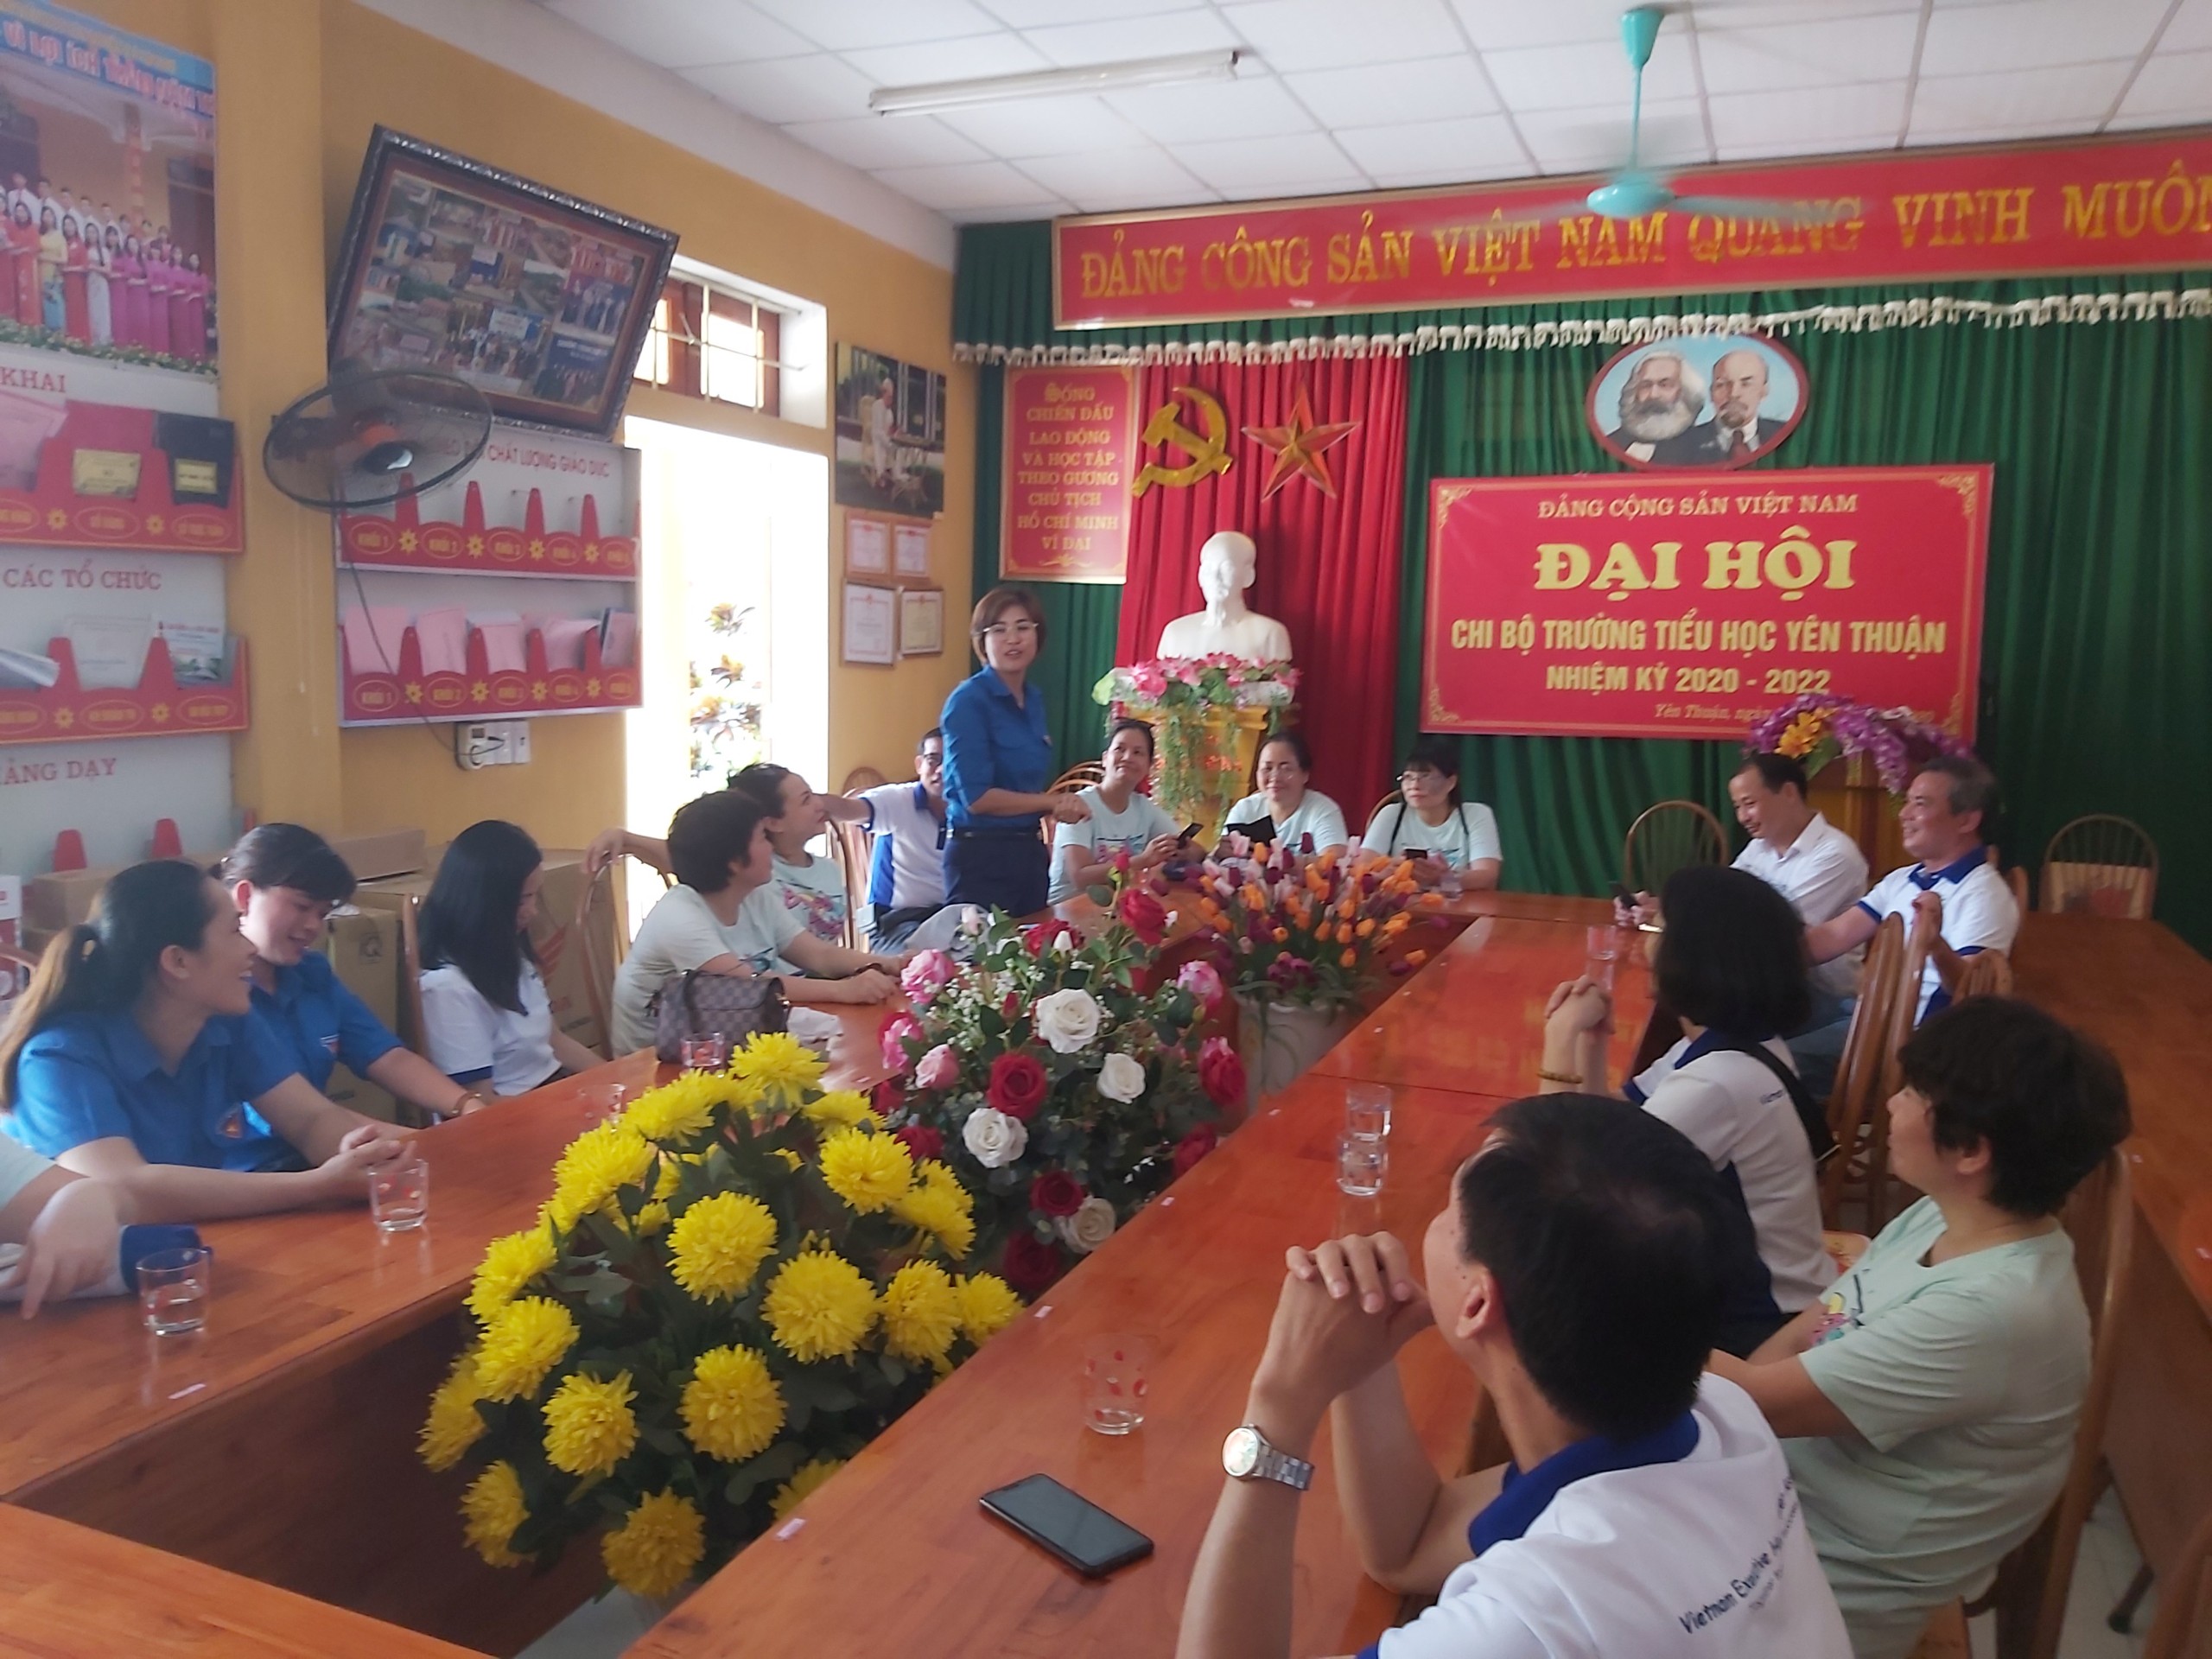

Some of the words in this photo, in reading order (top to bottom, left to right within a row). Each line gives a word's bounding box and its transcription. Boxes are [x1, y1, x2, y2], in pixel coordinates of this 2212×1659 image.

[1080, 229, 1185, 299] ĐẢNG
[1326, 210, 1412, 285] SẢN
[1432, 207, 1541, 287] VIỆT
[1556, 212, 1668, 270] NAM
[1688, 196, 1865, 264] QUANG
[1892, 188, 2036, 249] VINH
[0, 366, 67, 393] KHAI
[1028, 430, 1061, 446] LAO
[1538, 494, 1606, 518] ĐẢNG
[1609, 497, 1675, 521] CỘNG
[1678, 492, 1731, 516] SẢN
[1735, 491, 1795, 519] VIỆT
[1798, 493, 1859, 514] NAM
[3, 564, 54, 588] CÁC
[61, 559, 93, 588] TỔ
[101, 565, 162, 591] CHỨC
[1533, 541, 1683, 601] ĐẠI
[1701, 524, 1859, 602] HỘI
[1451, 619, 1492, 650] CHI
[1499, 613, 1535, 657] BỘ
[1654, 607, 1713, 652] TIỂU
[1719, 620, 1777, 659] HỌC
[1784, 614, 1841, 654] YÊN
[1849, 613, 1948, 660] THUẬN
[1546, 661, 1629, 697] NHIỆM
[1675, 666, 1739, 693] 2020
[1764, 668, 1831, 696] 2022
[67, 758, 118, 782] DẠY
